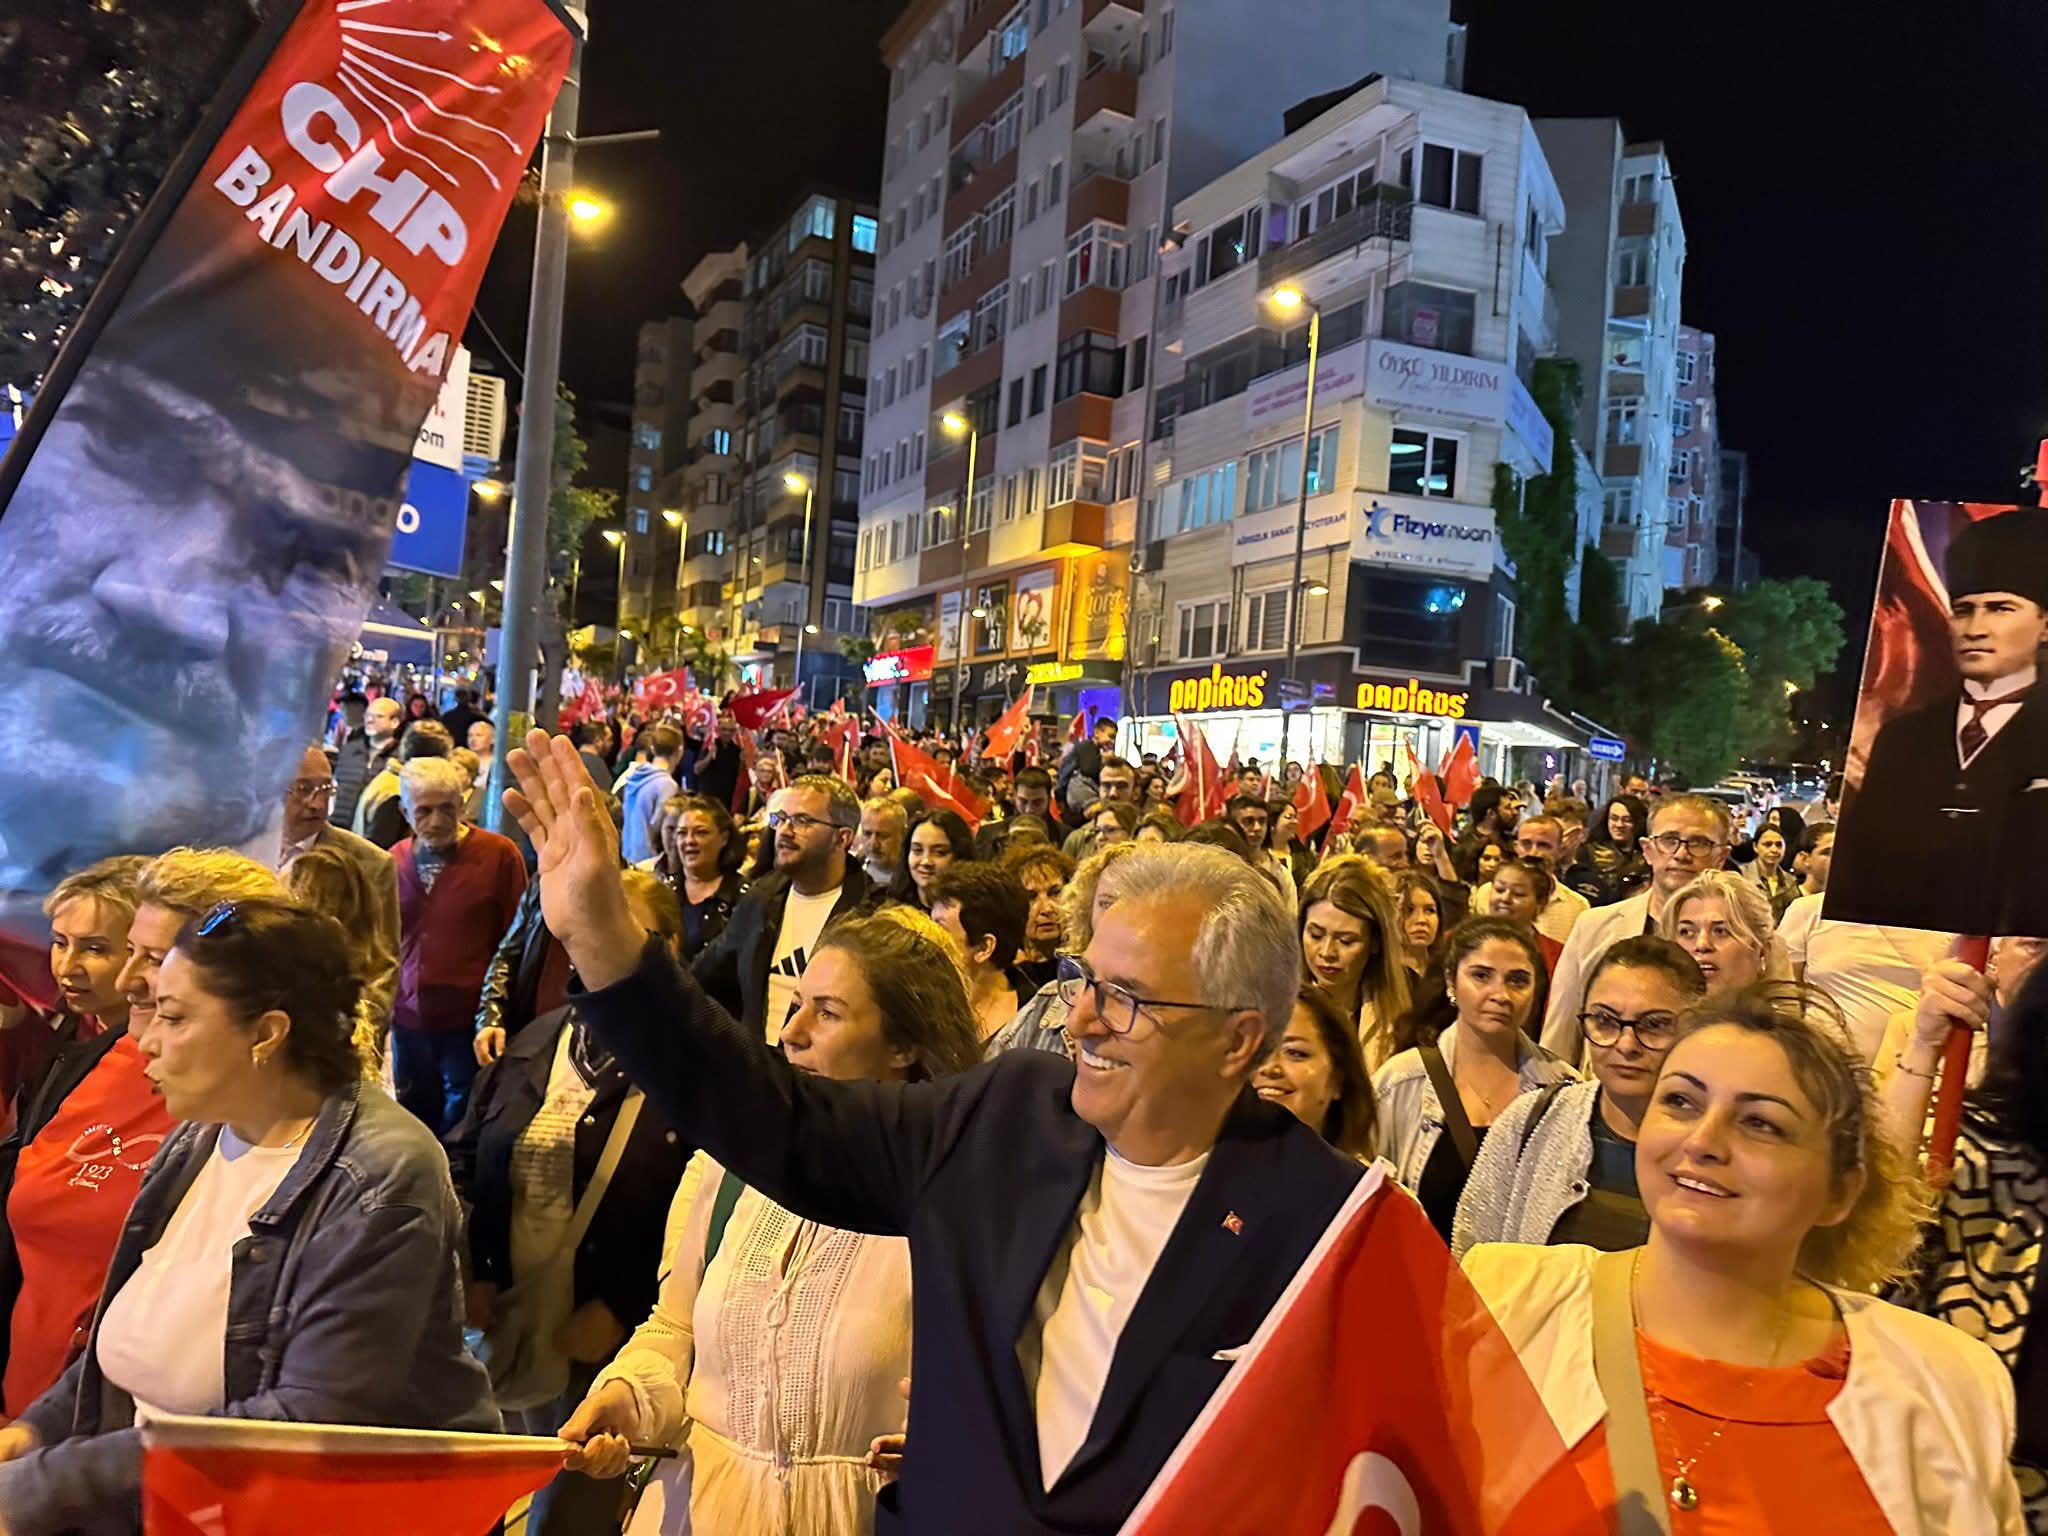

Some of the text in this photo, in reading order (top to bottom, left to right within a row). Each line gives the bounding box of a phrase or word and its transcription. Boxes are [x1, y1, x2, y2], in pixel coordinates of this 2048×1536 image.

[213, 144, 450, 377] BANDIRMA
[281, 81, 468, 267] CHP
[76, 1163, 114, 1180] 1923
